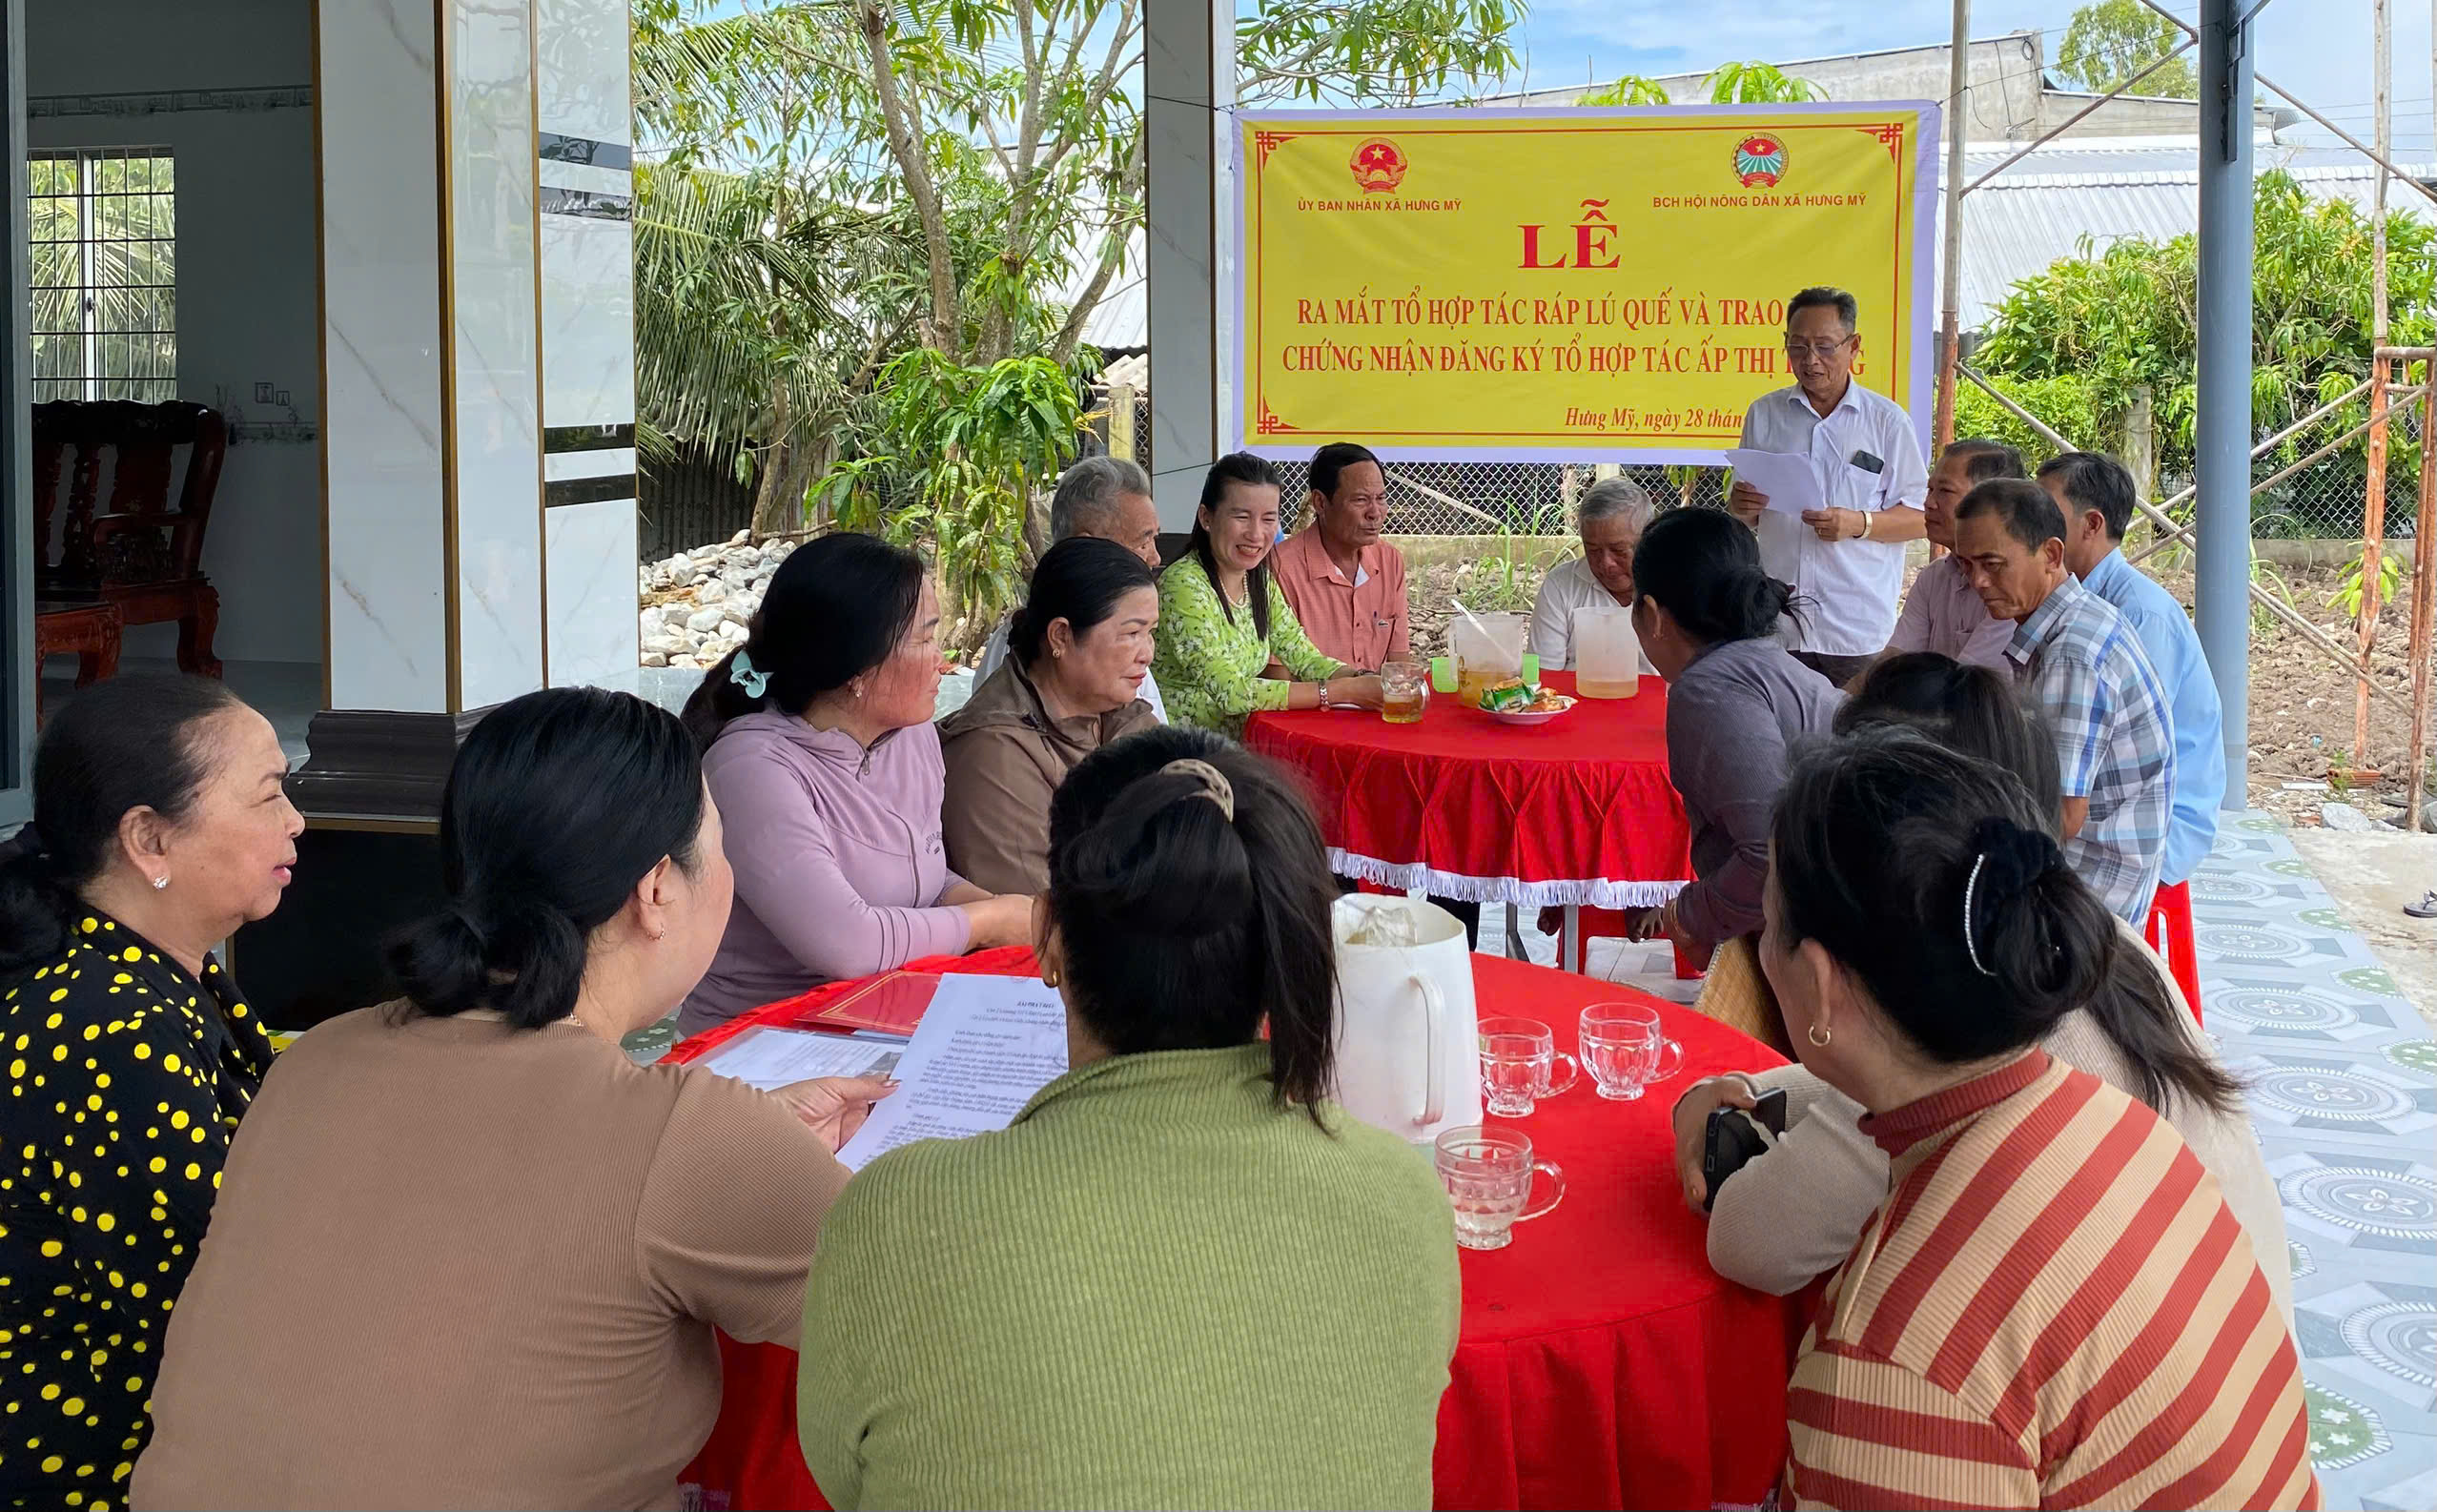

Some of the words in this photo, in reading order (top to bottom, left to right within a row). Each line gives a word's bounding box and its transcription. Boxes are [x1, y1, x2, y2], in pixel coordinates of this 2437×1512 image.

[1318, 200, 1342, 211] BAN
[1346, 197, 1381, 211] NHÂN
[1385, 197, 1402, 211] XÃ
[1405, 199, 1440, 211] HƯNG
[1444, 197, 1462, 211] MỸ
[1652, 196, 1679, 208] BCH
[1685, 194, 1707, 210] HỘI
[1710, 194, 1748, 207] NÔNG
[1752, 194, 1779, 207] DÂN
[1784, 193, 1801, 206] XÃ
[1806, 194, 1843, 206] HƯNG
[1847, 192, 1867, 205] MỸ
[1517, 198, 1621, 269] LỄ
[1298, 298, 1327, 324] RA
[1335, 285, 1385, 324] MẮT
[1391, 285, 1421, 325] TỔ
[1427, 296, 1474, 330] HỢP
[1480, 291, 1527, 324] TÁC
[1533, 291, 1580, 325] RÁP
[1586, 291, 1616, 325] LÚ
[1623, 286, 1672, 331] QUẾ
[1679, 291, 1710, 325] VÀ
[1718, 299, 1783, 326] TRAO
[1282, 337, 1363, 372] CHỨNG
[1370, 337, 1434, 377] NHẬN
[1440, 339, 1505, 372] ĐĂNG
[1512, 338, 1545, 372] KÝ
[1551, 333, 1582, 373] TỔ
[1588, 342, 1636, 378] HỢP
[1642, 338, 1690, 373] TÁC
[1696, 334, 1729, 373] ẤP
[1734, 347, 1775, 379] THỊ
[1565, 407, 1607, 431] Hưng
[1611, 407, 1639, 431] Mỹ,
[1644, 408, 1681, 431] ngày
[1684, 408, 1704, 428] 28
[1708, 408, 1742, 428] thán
